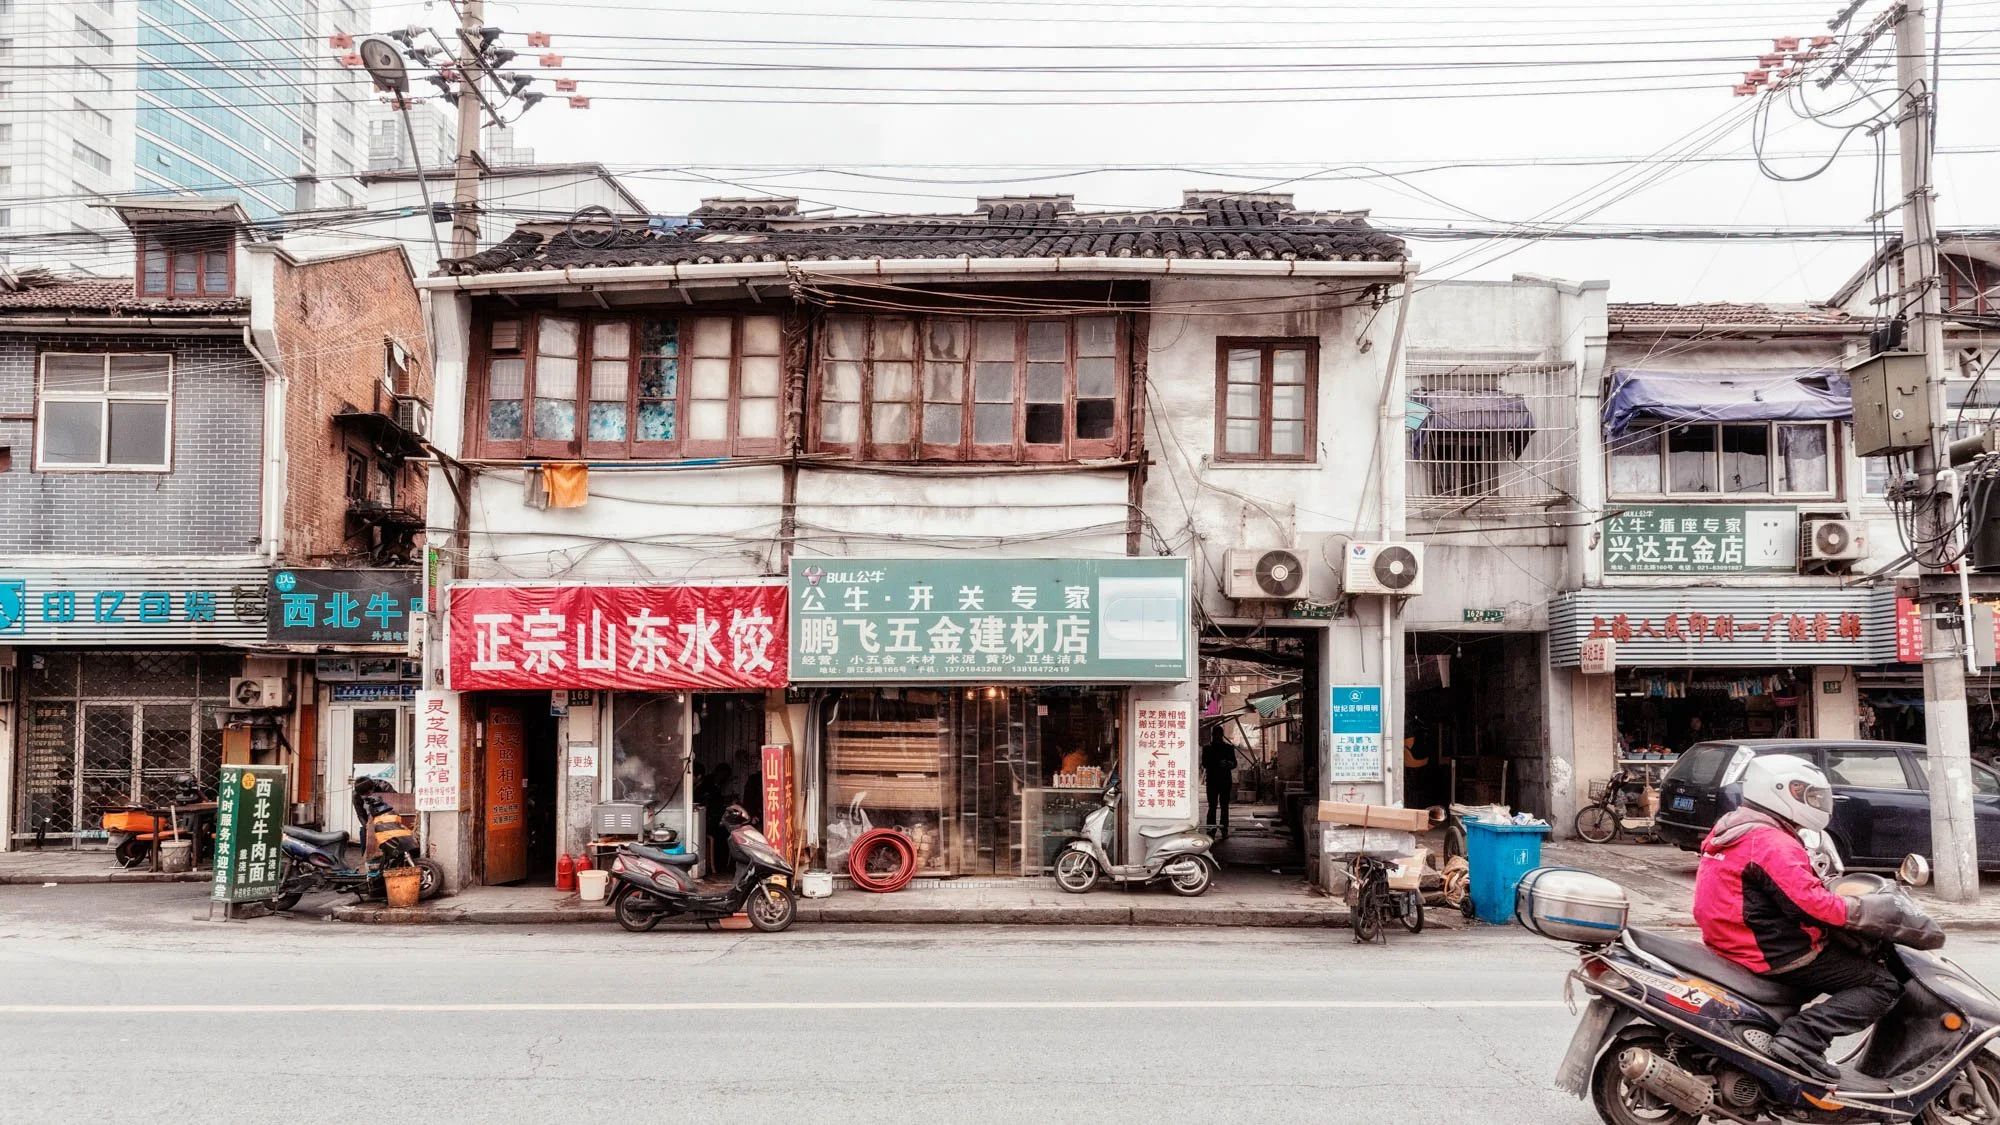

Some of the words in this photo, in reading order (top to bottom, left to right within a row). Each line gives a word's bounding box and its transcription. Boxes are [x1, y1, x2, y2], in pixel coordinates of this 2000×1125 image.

[1608, 518, 1742, 533] 公牛·插座专家
[1608, 535, 1744, 564] 兴达五金店
[42, 590, 217, 623] 印亿包装
[800, 585, 1091, 611] 公牛·开关专家
[470, 607, 776, 675] 正宗山东水饺
[799, 614, 1091, 655] 鹏飞五金建材店
[1588, 611, 1864, 644] 上海人民印刷一厂经营部
[801, 655, 840, 666] 经营：
[850, 655, 897, 665] 小五金
[906, 655, 937, 665] 木材
[945, 655, 976, 665] 水泥
[985, 655, 1016, 665] 黄沙
[1025, 655, 1088, 665] 卫生洁具
[571, 690, 590, 700] 168
[1138, 709, 1187, 720] 灵芝照相馆
[424, 698, 450, 784] 灵芝照相馆
[1138, 740, 1186, 749] 向北走十步
[1137, 769, 1187, 778] 各种证件照
[766, 753, 781, 855] 山东水
[1137, 799, 1176, 808] 立等可取
[248, 778, 273, 883] 西北牛肉面
